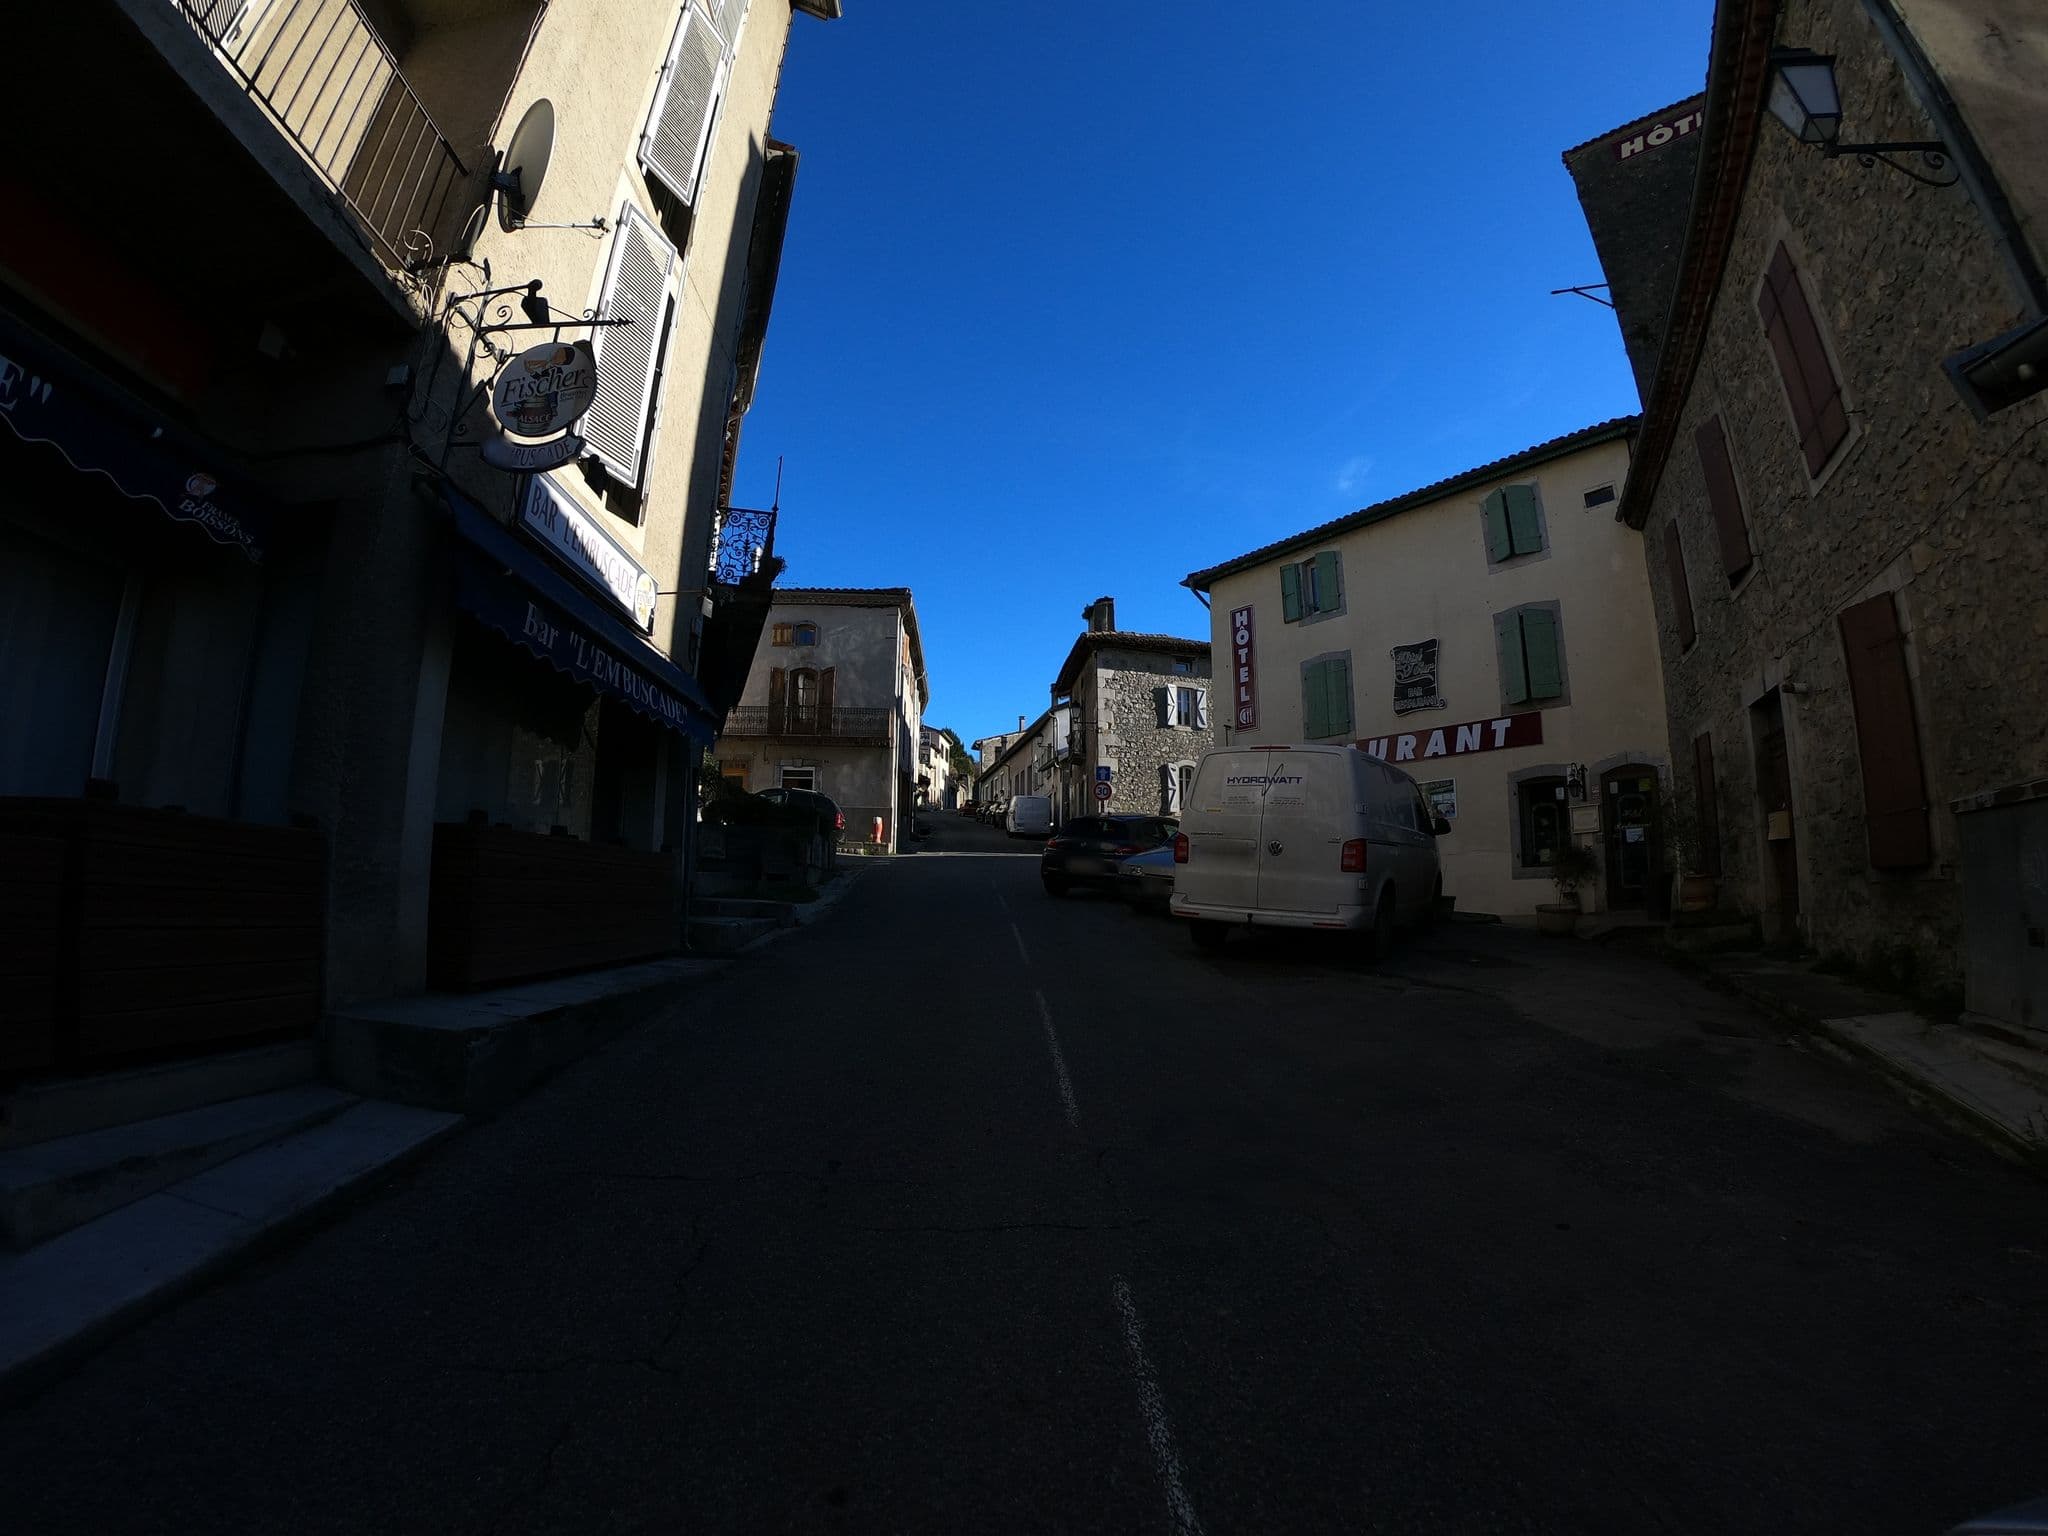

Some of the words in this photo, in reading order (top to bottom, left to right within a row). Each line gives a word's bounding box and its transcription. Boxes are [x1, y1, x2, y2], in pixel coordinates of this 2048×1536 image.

[501, 367, 585, 404] Fischer
[530, 484, 559, 533] BAR
[563, 515, 636, 602] L'EMBUSCADE
[523, 600, 560, 650] Bar
[1234, 609, 1250, 703] HÔTEL
[1347, 717, 1512, 763] URANT
[1096, 786, 1109, 797] 30
[1226, 776, 1303, 785] HYDROWATT
